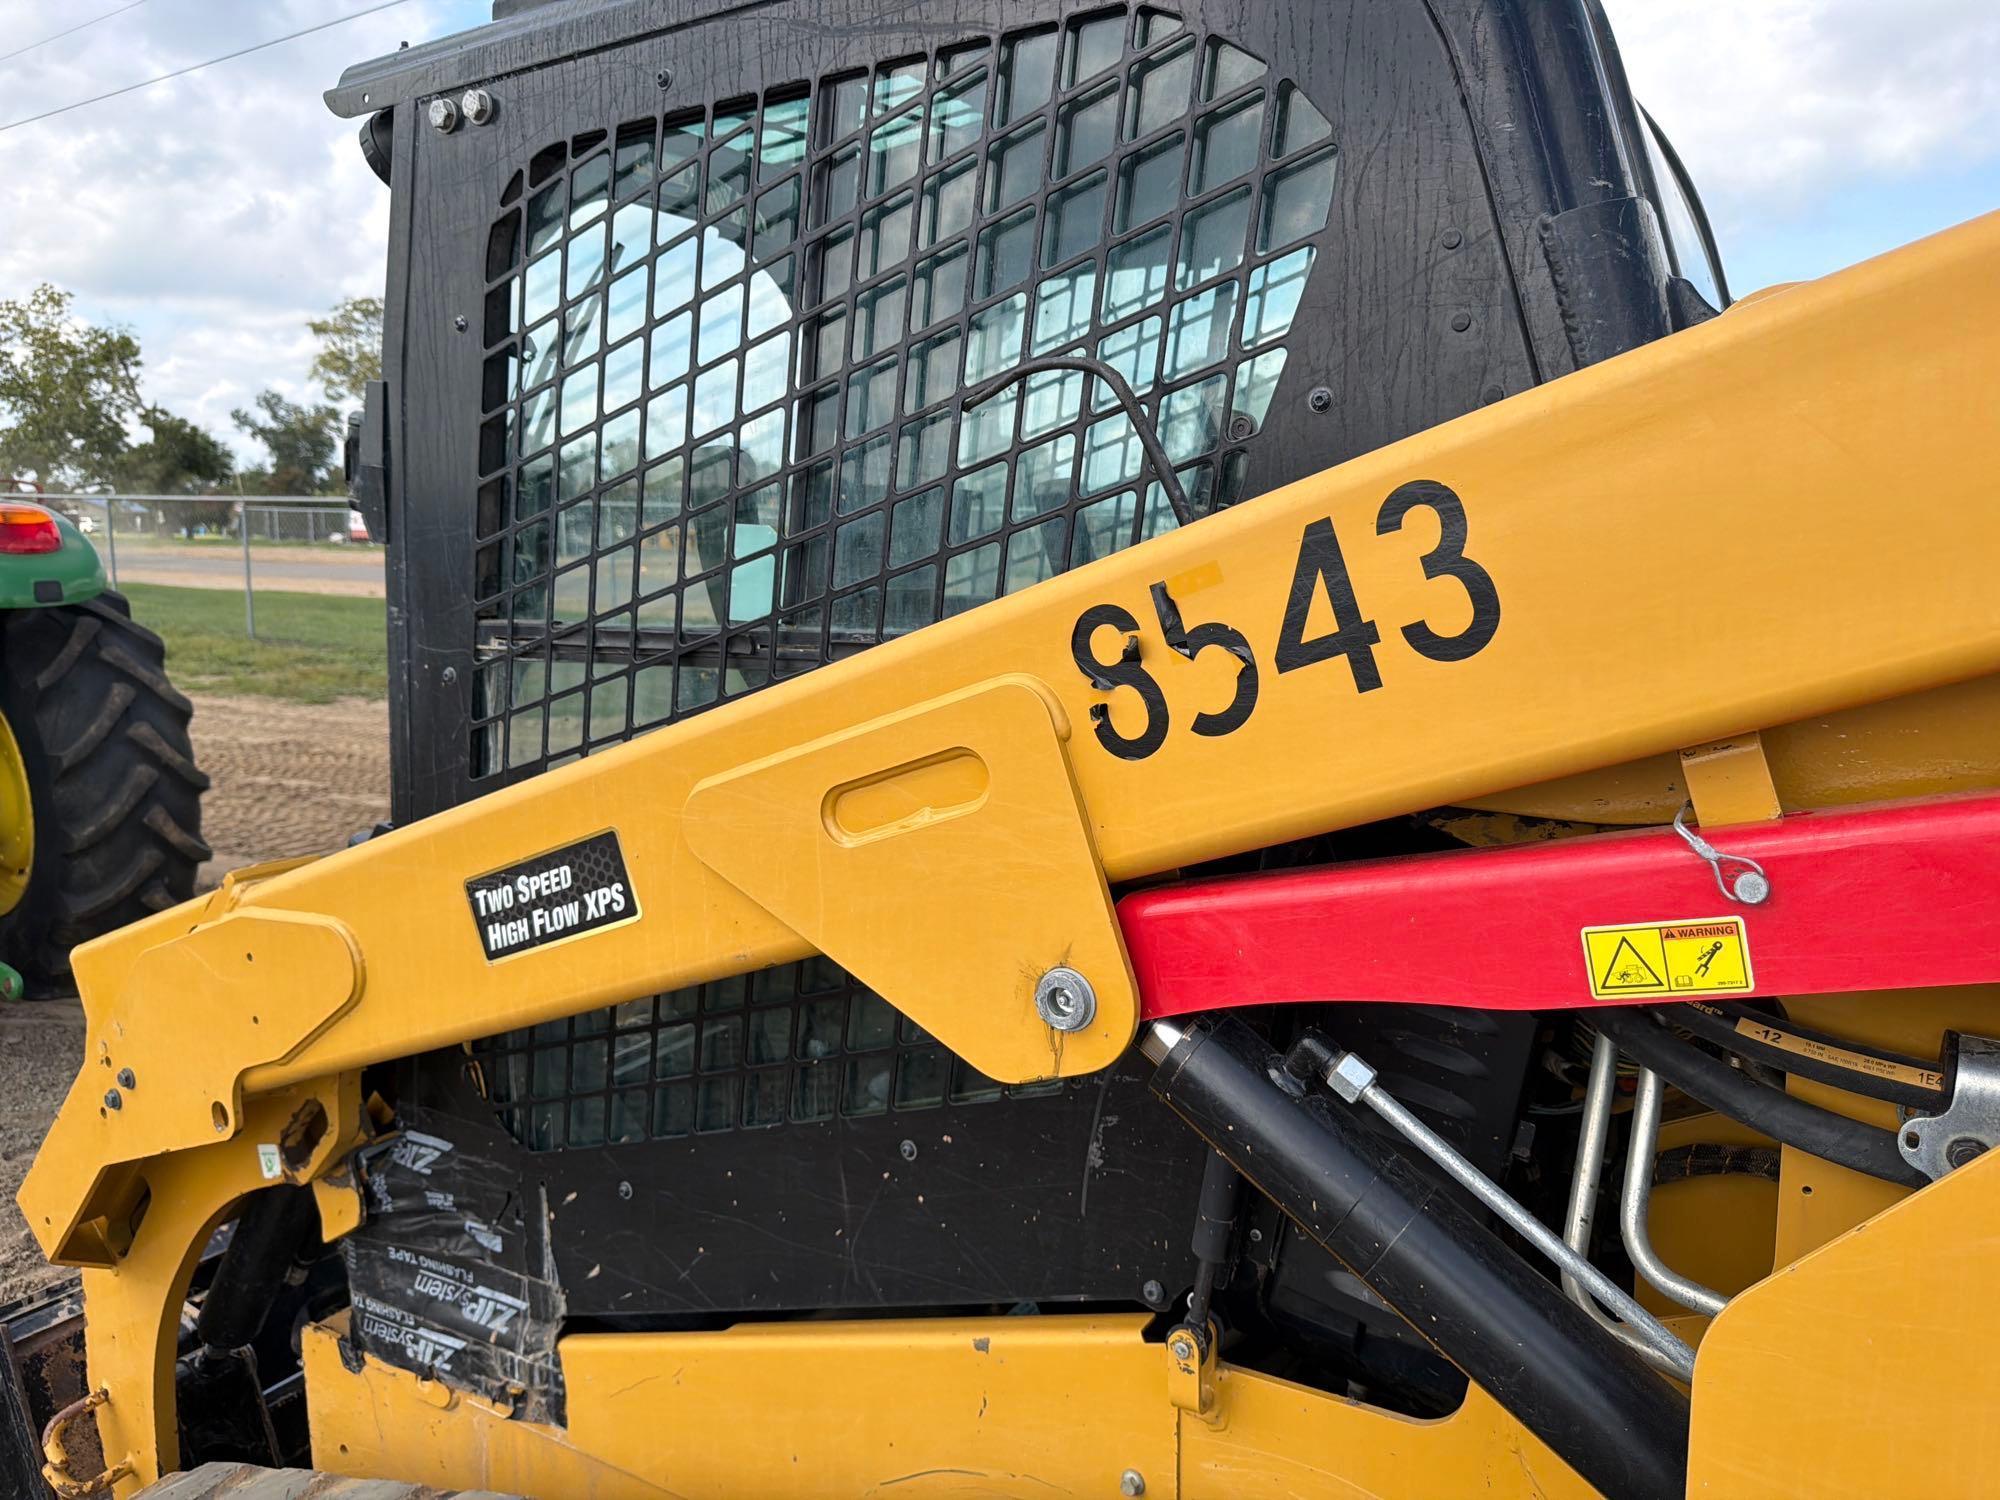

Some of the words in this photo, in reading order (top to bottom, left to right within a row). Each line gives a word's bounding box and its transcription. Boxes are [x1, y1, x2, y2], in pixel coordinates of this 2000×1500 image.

[1071, 479, 1500, 761] 8543
[475, 885, 514, 917] TWO
[517, 865, 572, 904] SPEED
[487, 918, 530, 951] HIGH
[532, 901, 579, 937] FLOW
[583, 882, 625, 922] XPS
[1678, 925, 1734, 938] WARNING
[1755, 1029, 1782, 1044] -12
[387, 1246, 419, 1266] TAPE
[419, 1256, 475, 1284] FLASHING
[365, 1298, 415, 1326] FLASHING
